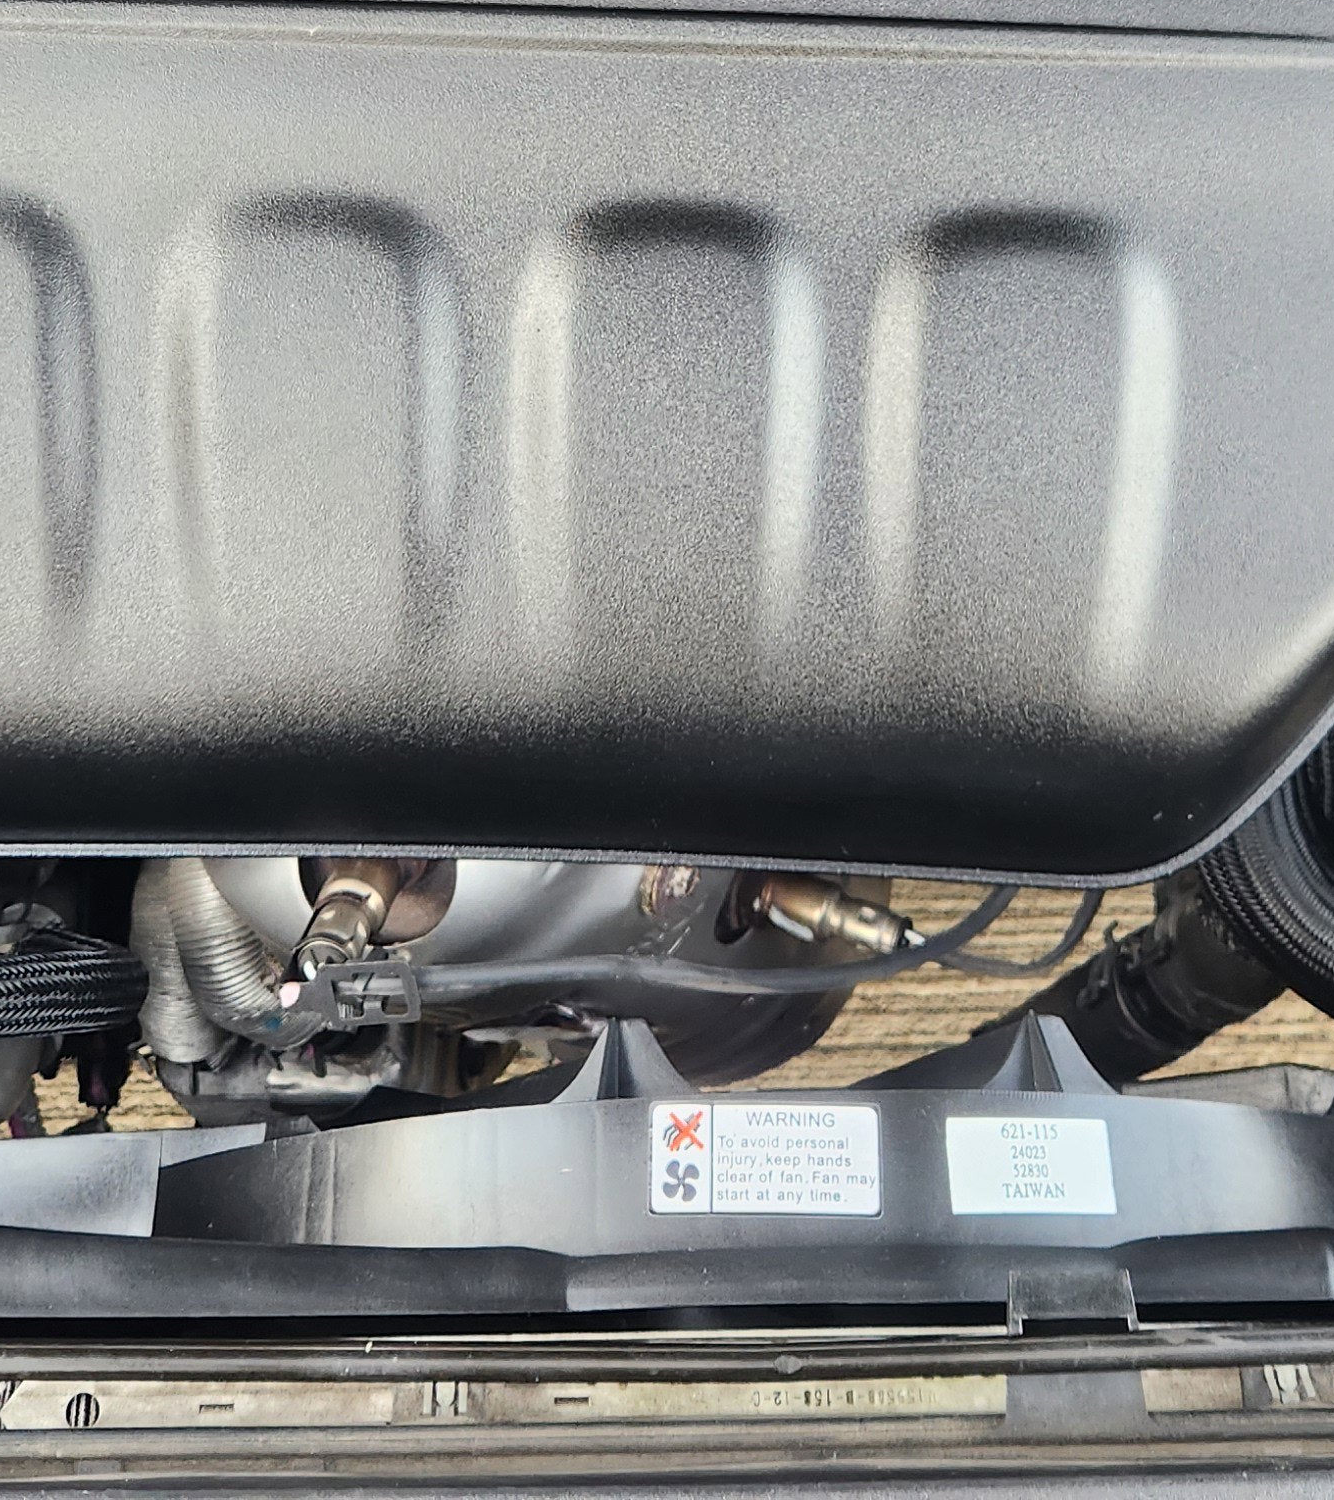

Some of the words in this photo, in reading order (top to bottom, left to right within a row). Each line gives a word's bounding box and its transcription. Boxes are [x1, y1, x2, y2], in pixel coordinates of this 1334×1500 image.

[746, 1111, 835, 1128] WARNING
[1000, 1123, 1058, 1140] 621-115
[717, 1135, 733, 1148] To
[741, 1135, 779, 1149] avoid
[786, 1137, 849, 1153] personal
[1011, 1145, 1047, 1160] 24023
[766, 1153, 800, 1168] keep
[807, 1154, 852, 1167] hands
[717, 1170, 753, 1184] clear
[759, 1170, 773, 1184] of
[780, 1170, 808, 1185] fan.
[812, 1171, 840, 1185] Fan
[846, 1174, 876, 1188] may
[1013, 1163, 1049, 1178] 52830
[717, 1187, 749, 1202] start
[756, 1188, 770, 1201] at
[777, 1190, 803, 1205] any
[810, 1188, 848, 1203] time.
[1002, 1183, 1065, 1199] TAIWAN
